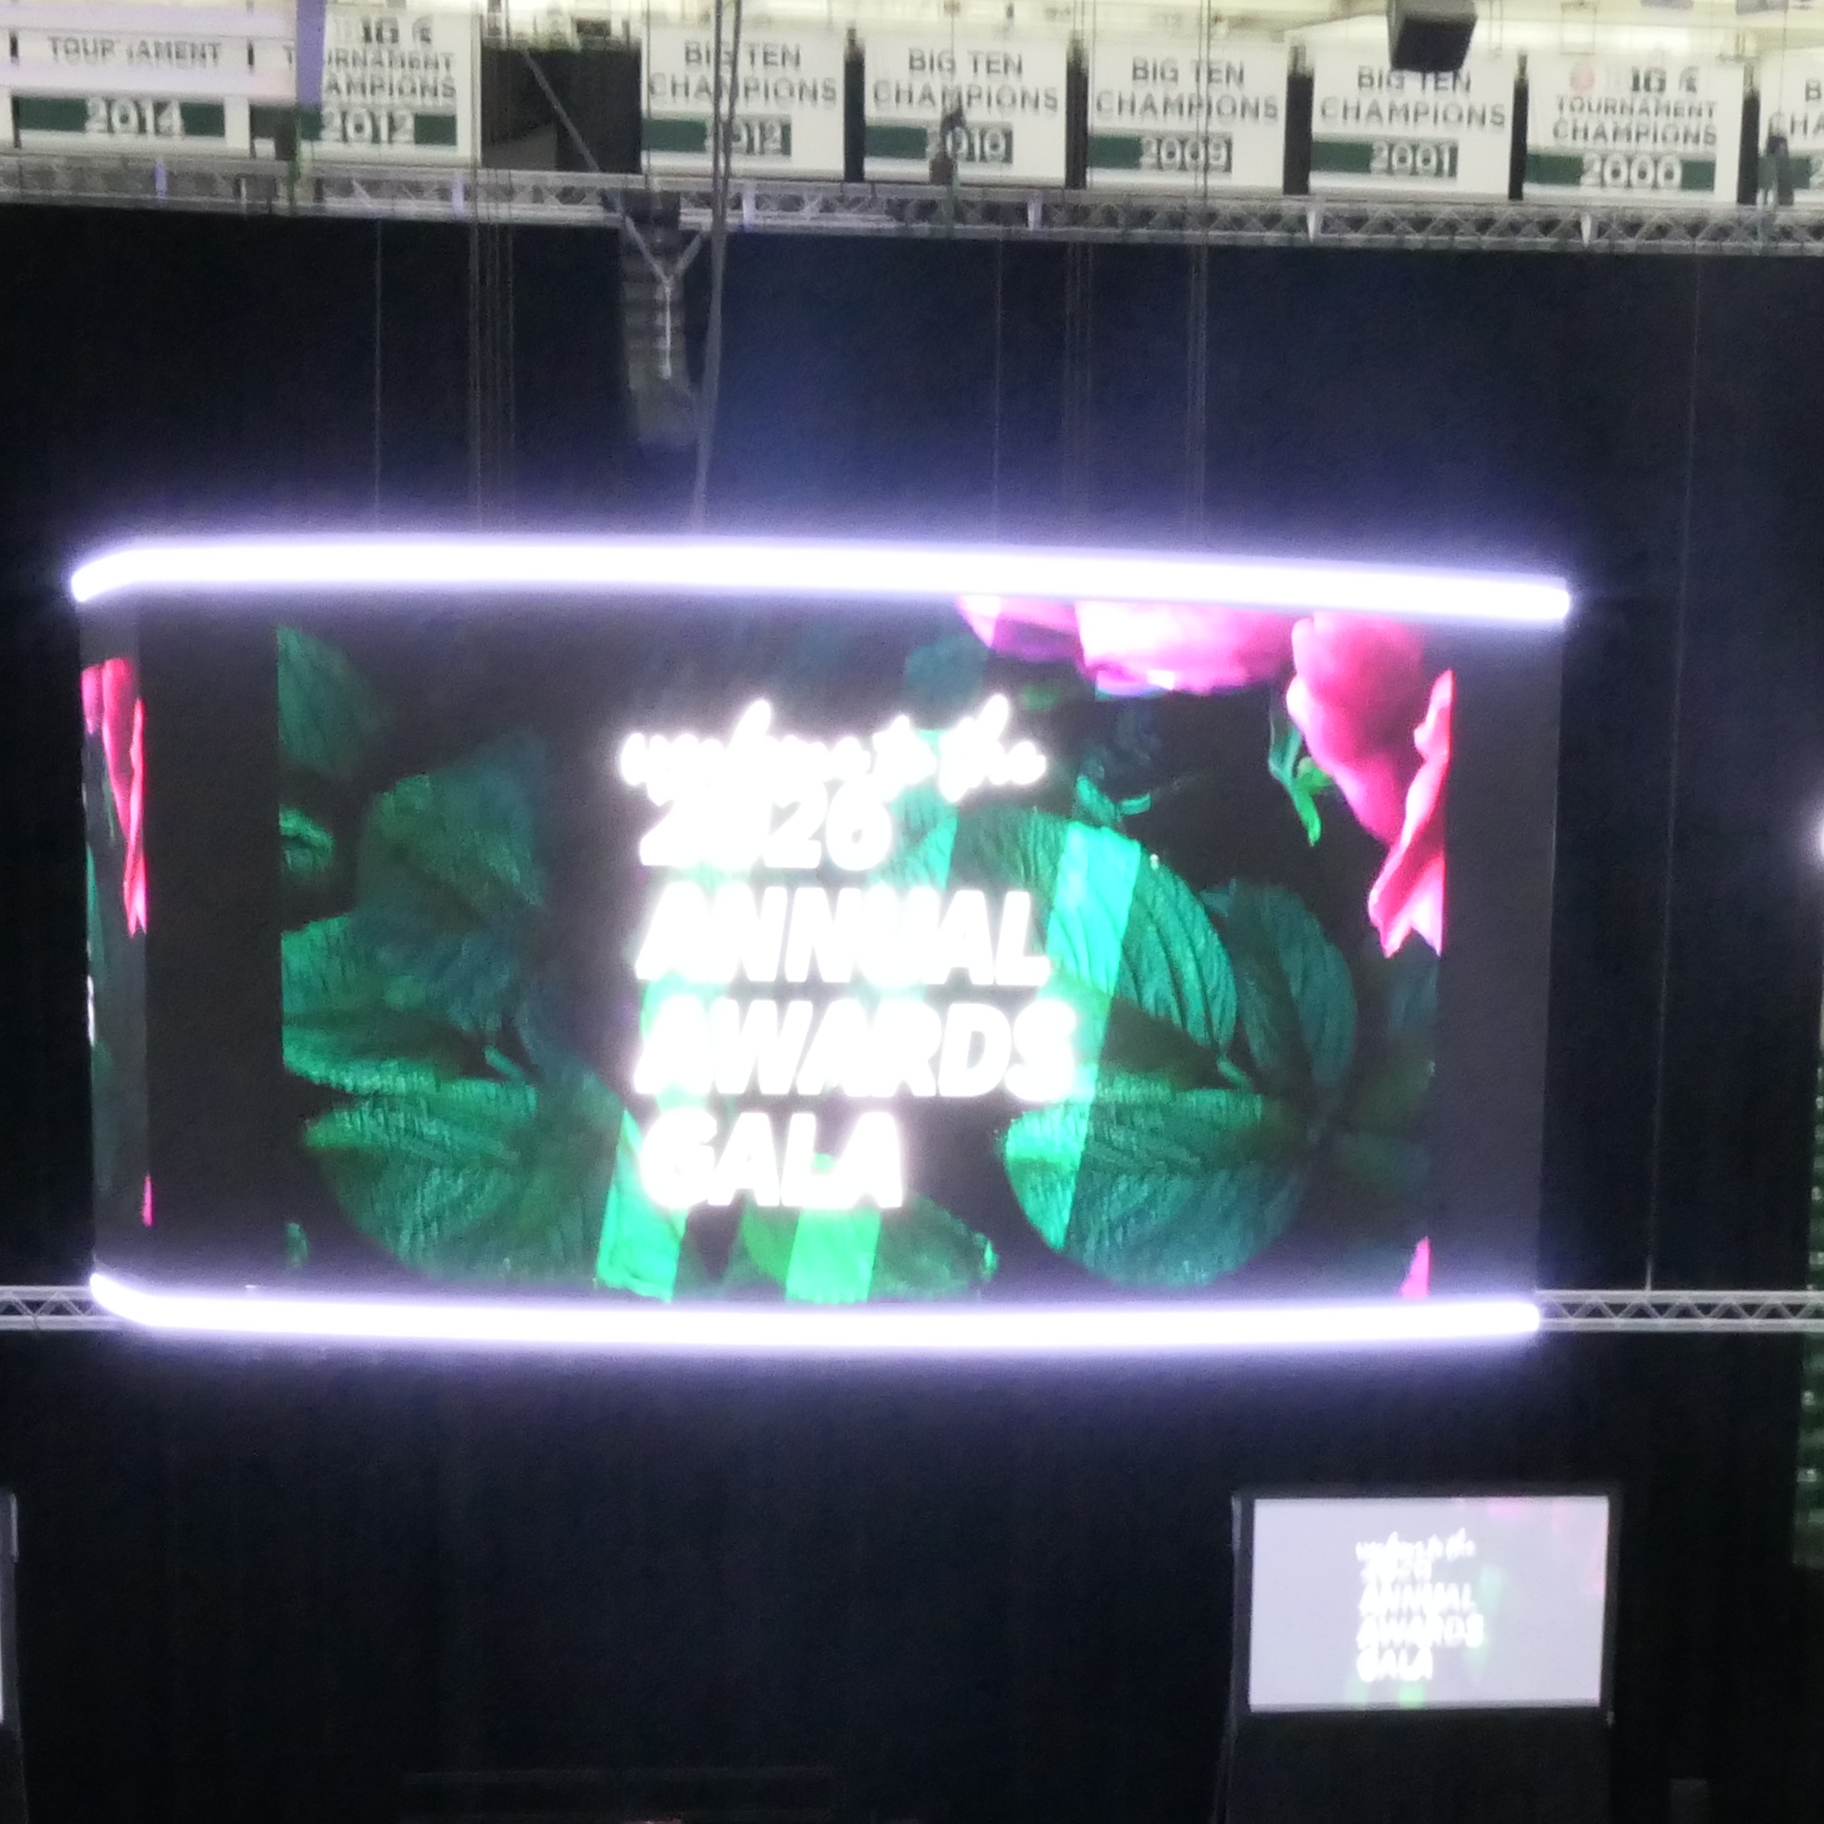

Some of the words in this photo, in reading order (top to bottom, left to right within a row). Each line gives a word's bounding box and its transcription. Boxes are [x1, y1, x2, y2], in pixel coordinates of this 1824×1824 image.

[283, 44, 455, 72] TRNAMENT
[746, 43, 800, 71] TEN
[909, 49, 956, 75] BIG
[967, 51, 1023, 77] TEN
[1132, 57, 1179, 84] BIG
[1191, 59, 1244, 88] TEN
[324, 74, 456, 102] AMPIONS
[873, 79, 1059, 114] CHAMPIONS
[1358, 66, 1406, 92] BIG
[86, 96, 185, 136] 2014
[1096, 90, 1279, 123] CHAMPIONS
[1321, 96, 1506, 130] CHAMPIONS
[1555, 96, 1717, 118] TOURNAMENT
[320, 107, 415, 144] 2012
[1553, 117, 1717, 147] CHAMPIONS
[1139, 133, 1227, 169] 2009
[1370, 140, 1453, 176] 2001
[1580, 152, 1683, 190] 2000
[639, 779, 894, 871] 2026
[635, 882, 1051, 987] ANNUAL
[633, 994, 1077, 1103] AWARDS
[638, 1105, 904, 1211] GALA
[1359, 1582, 1477, 1617] ANNUAL
[1356, 1614, 1484, 1649] AWARDS
[1356, 1646, 1433, 1683] GALA
